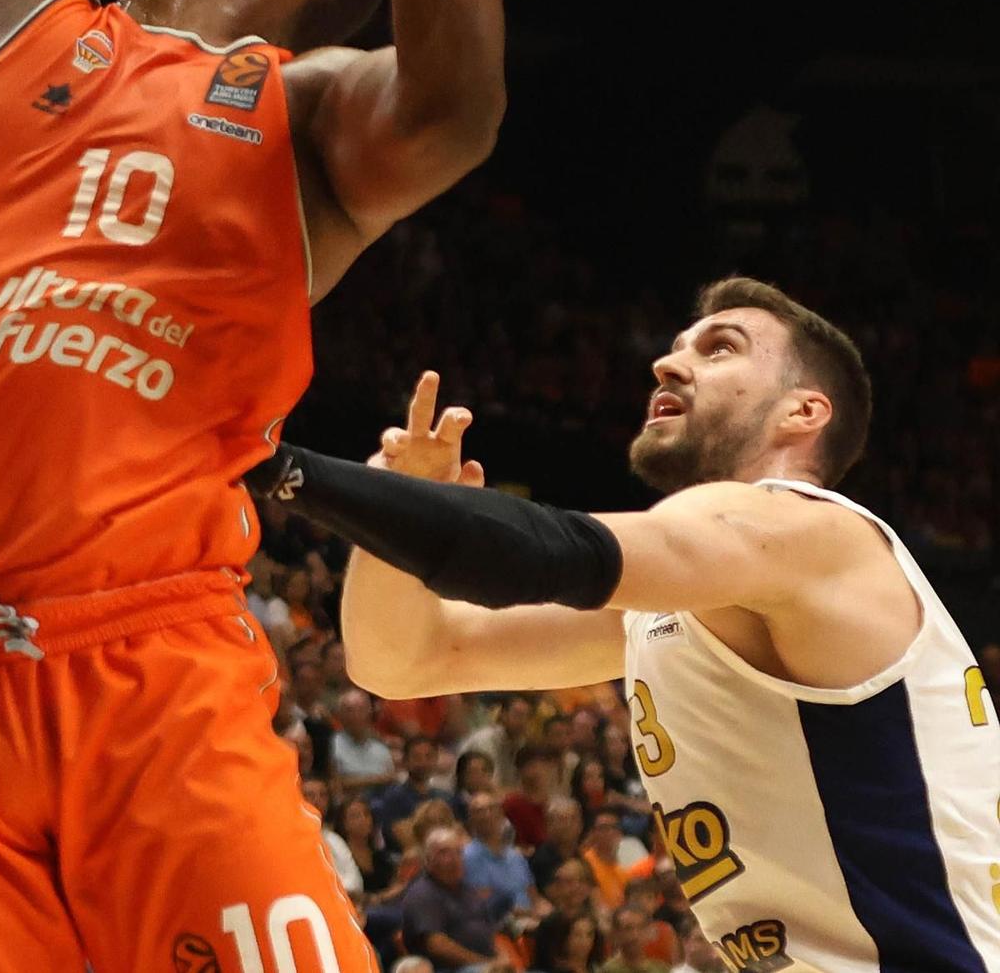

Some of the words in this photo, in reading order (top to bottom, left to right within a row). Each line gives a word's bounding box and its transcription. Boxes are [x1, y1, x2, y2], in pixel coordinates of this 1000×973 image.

[188, 114, 263, 144] oneteam
[61, 148, 175, 247] 10
[148, 314, 195, 348] del
[221, 893, 342, 973] 10
